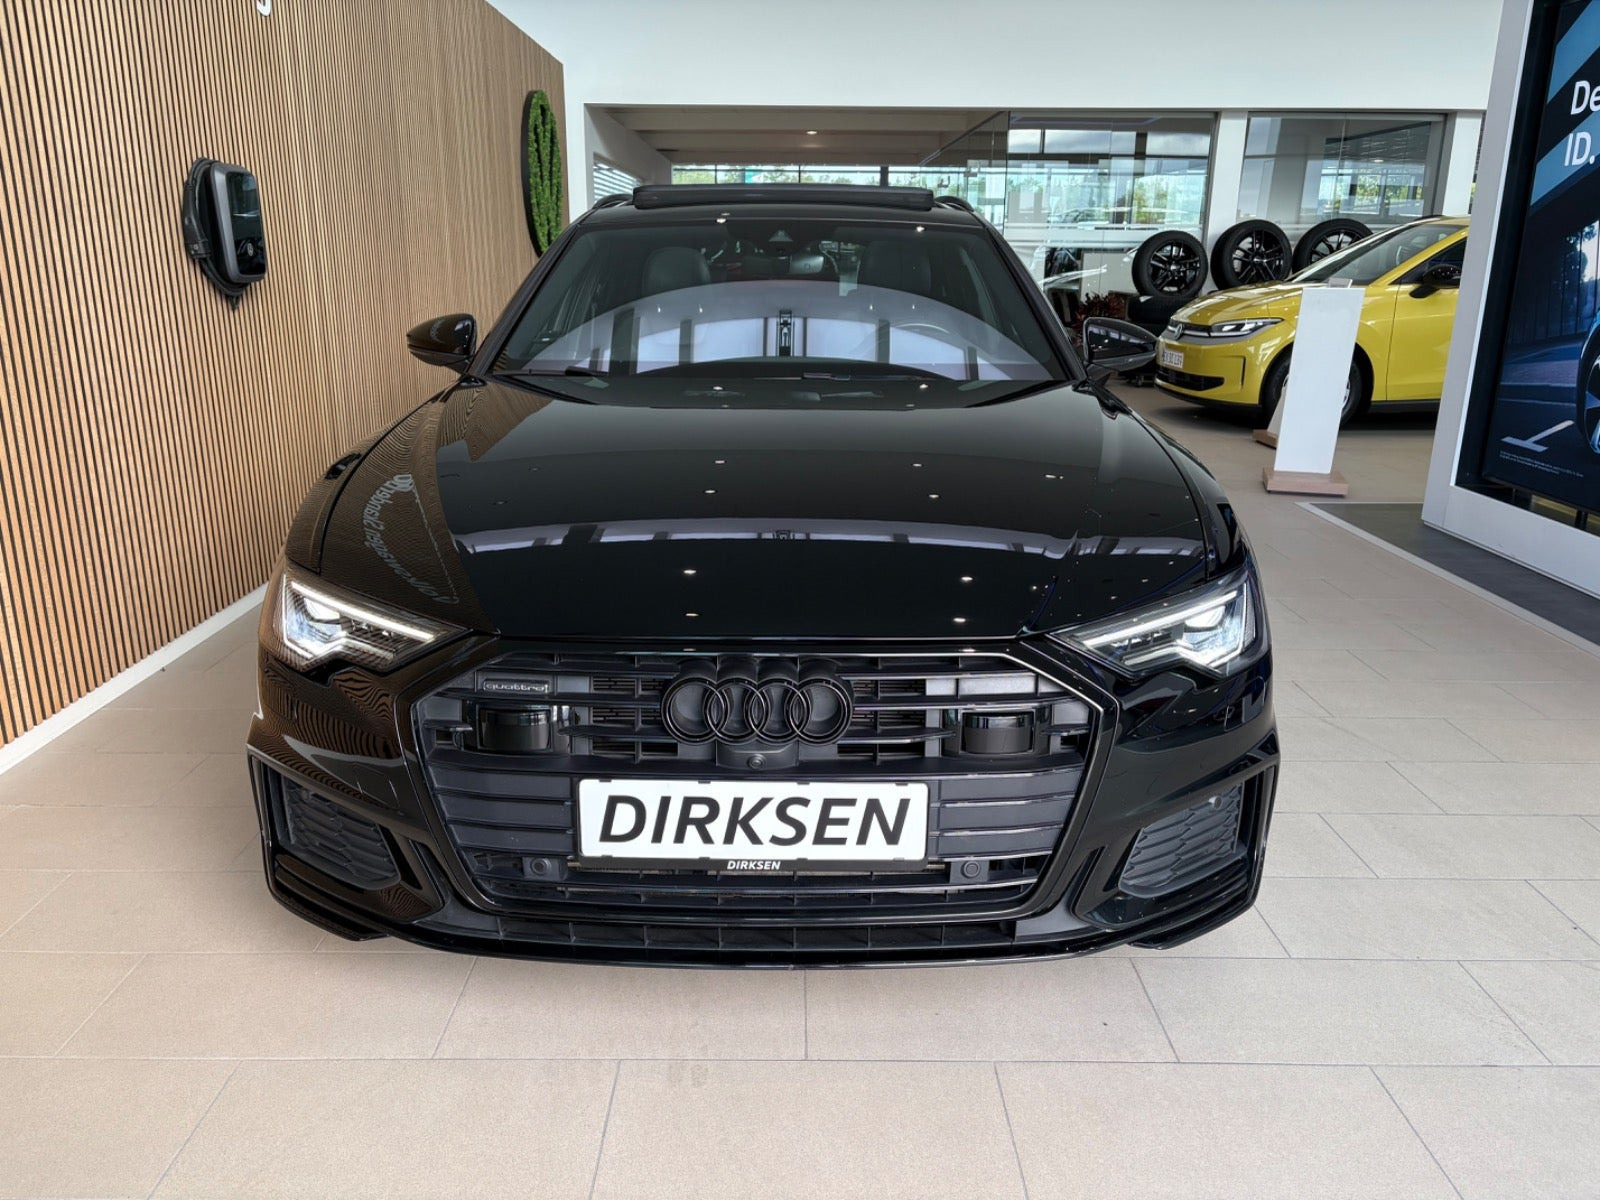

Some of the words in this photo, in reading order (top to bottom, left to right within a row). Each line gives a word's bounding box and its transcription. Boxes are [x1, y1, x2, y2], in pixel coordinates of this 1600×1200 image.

[1564, 131, 1595, 167] ID.
[485, 682, 546, 692] quattro
[599, 795, 911, 847] DIRKSEN
[727, 860, 781, 870] DIRKSEN
